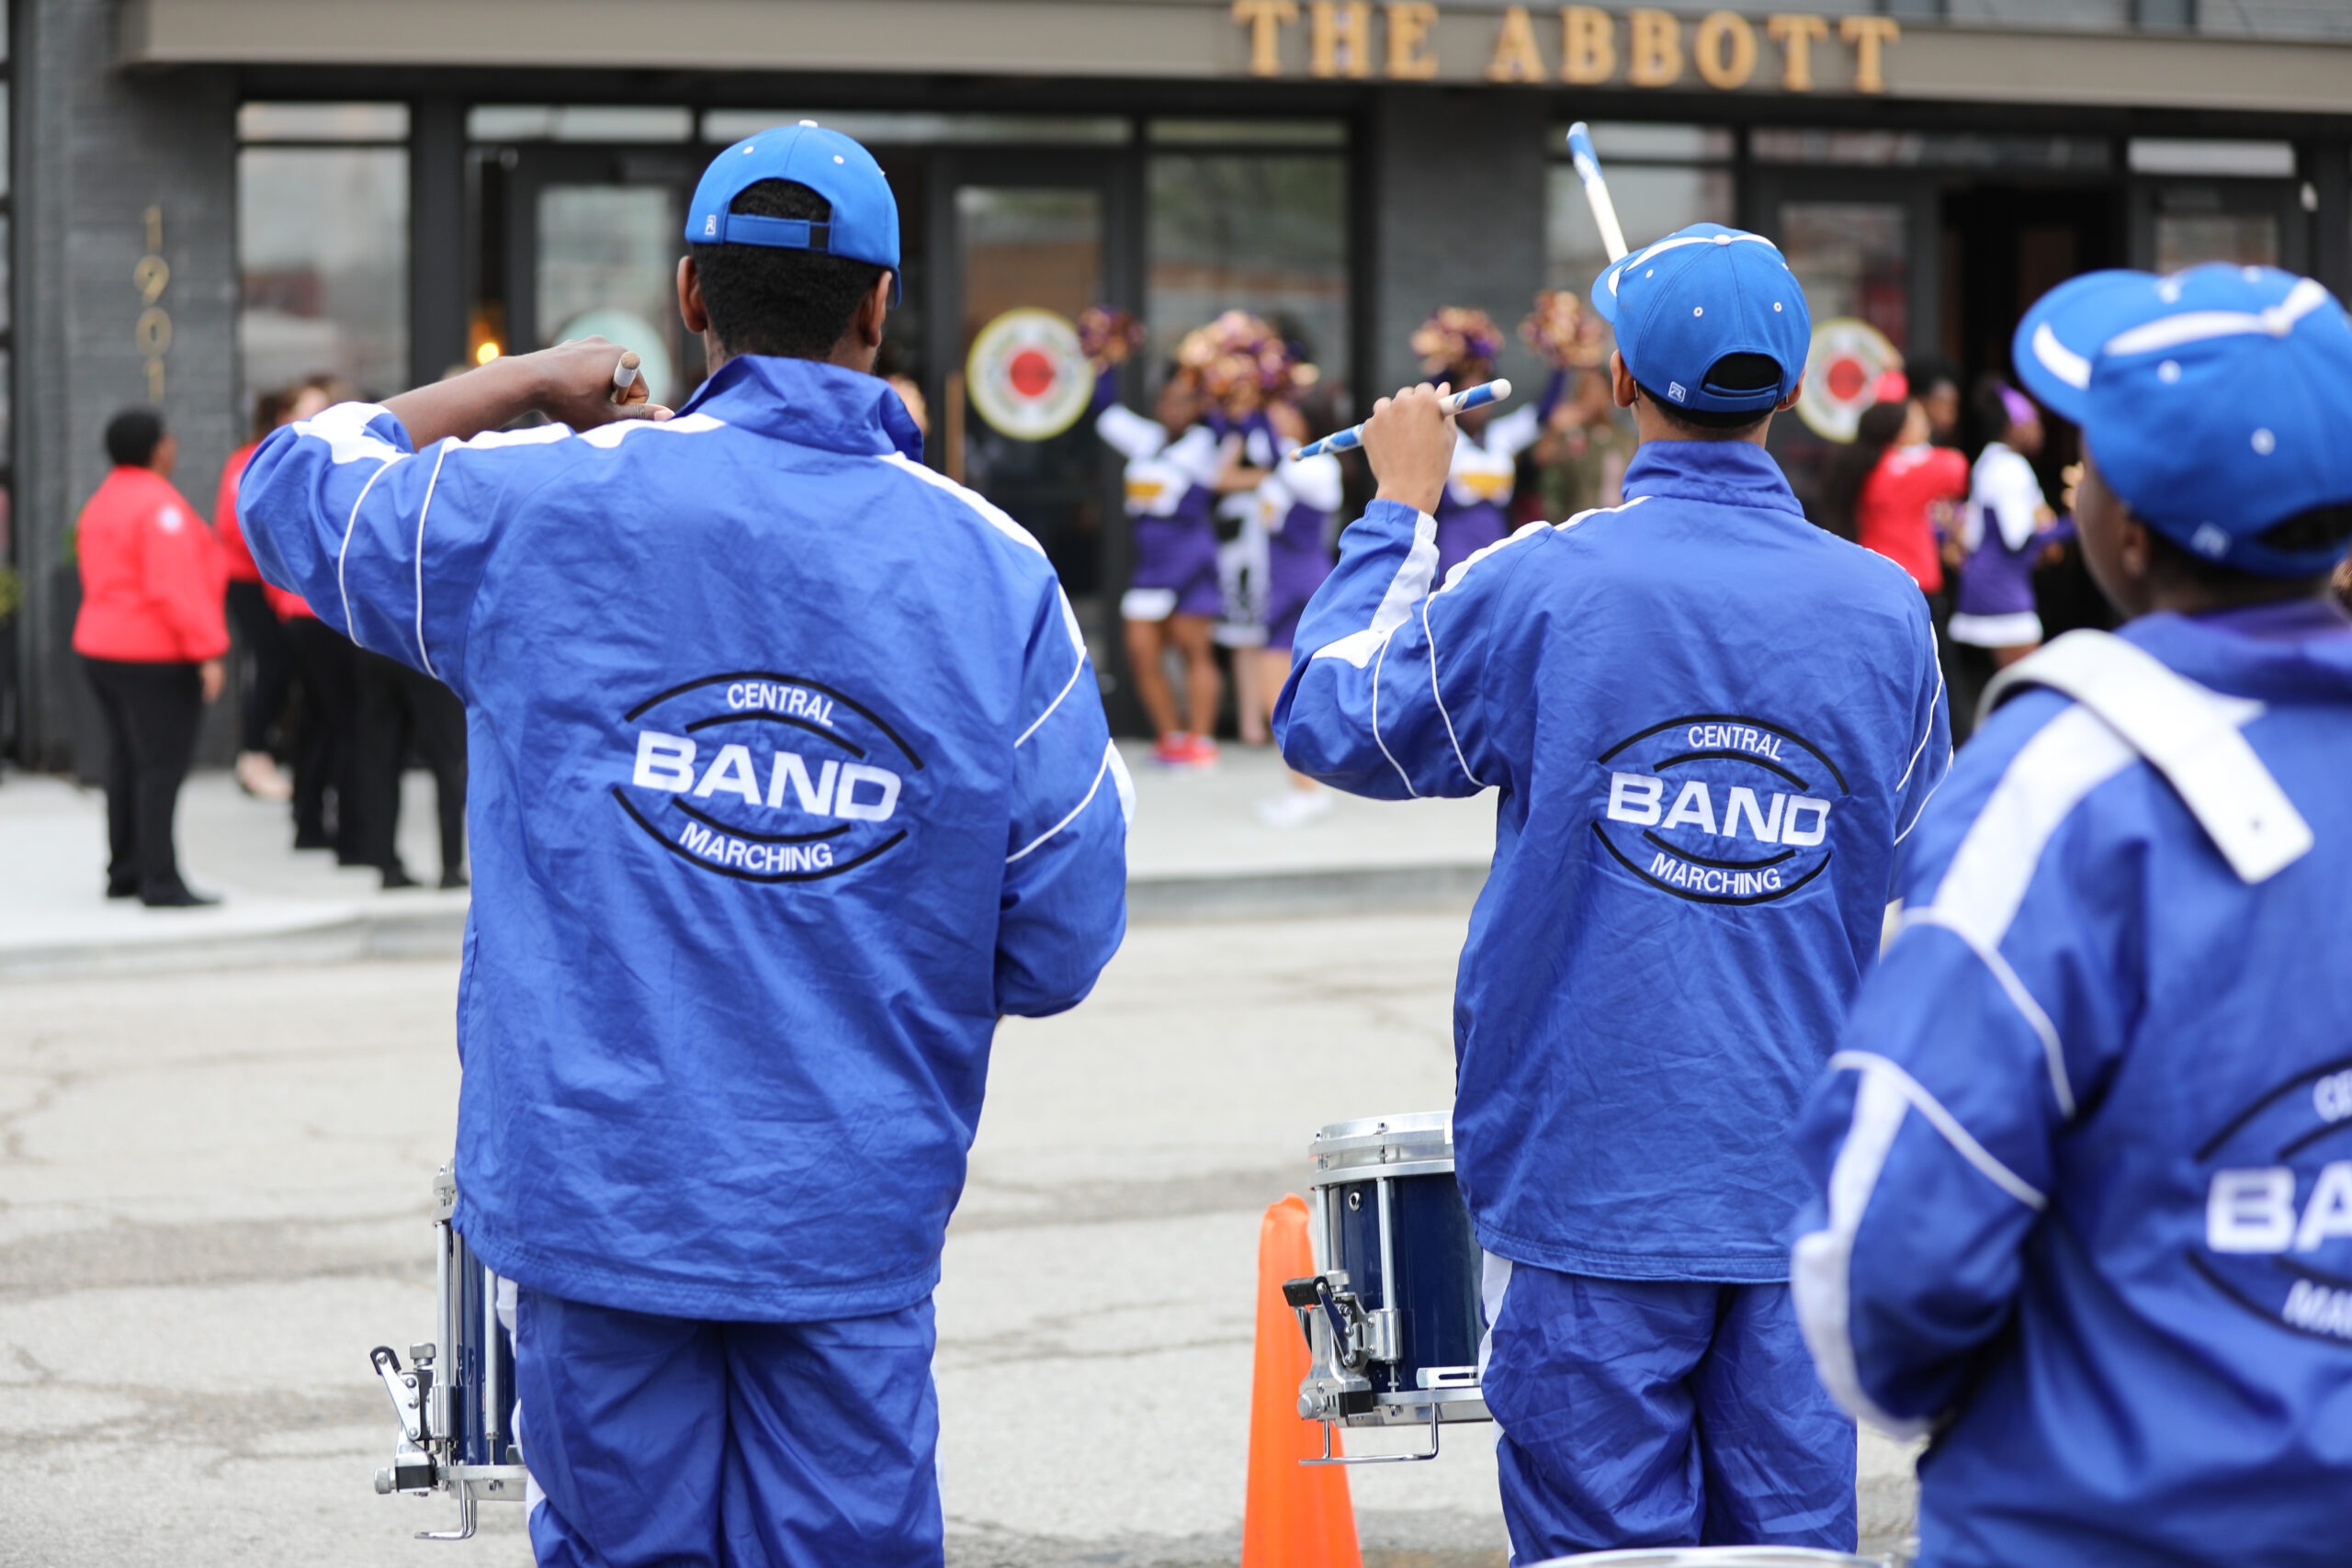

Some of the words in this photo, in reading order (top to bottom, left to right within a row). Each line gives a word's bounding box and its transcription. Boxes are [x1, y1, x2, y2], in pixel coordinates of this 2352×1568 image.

[1231, 0, 1439, 79] THE
[1485, 4, 1900, 92] ABBOTT
[133, 205, 173, 402] 1901
[727, 683, 834, 727] CENTRAL
[1688, 725, 1781, 761] CENTRAL
[633, 730, 902, 822] BAND
[1607, 772, 1831, 846] BAND
[679, 821, 833, 872] MARCHING
[1650, 852, 1781, 894] MARCHING
